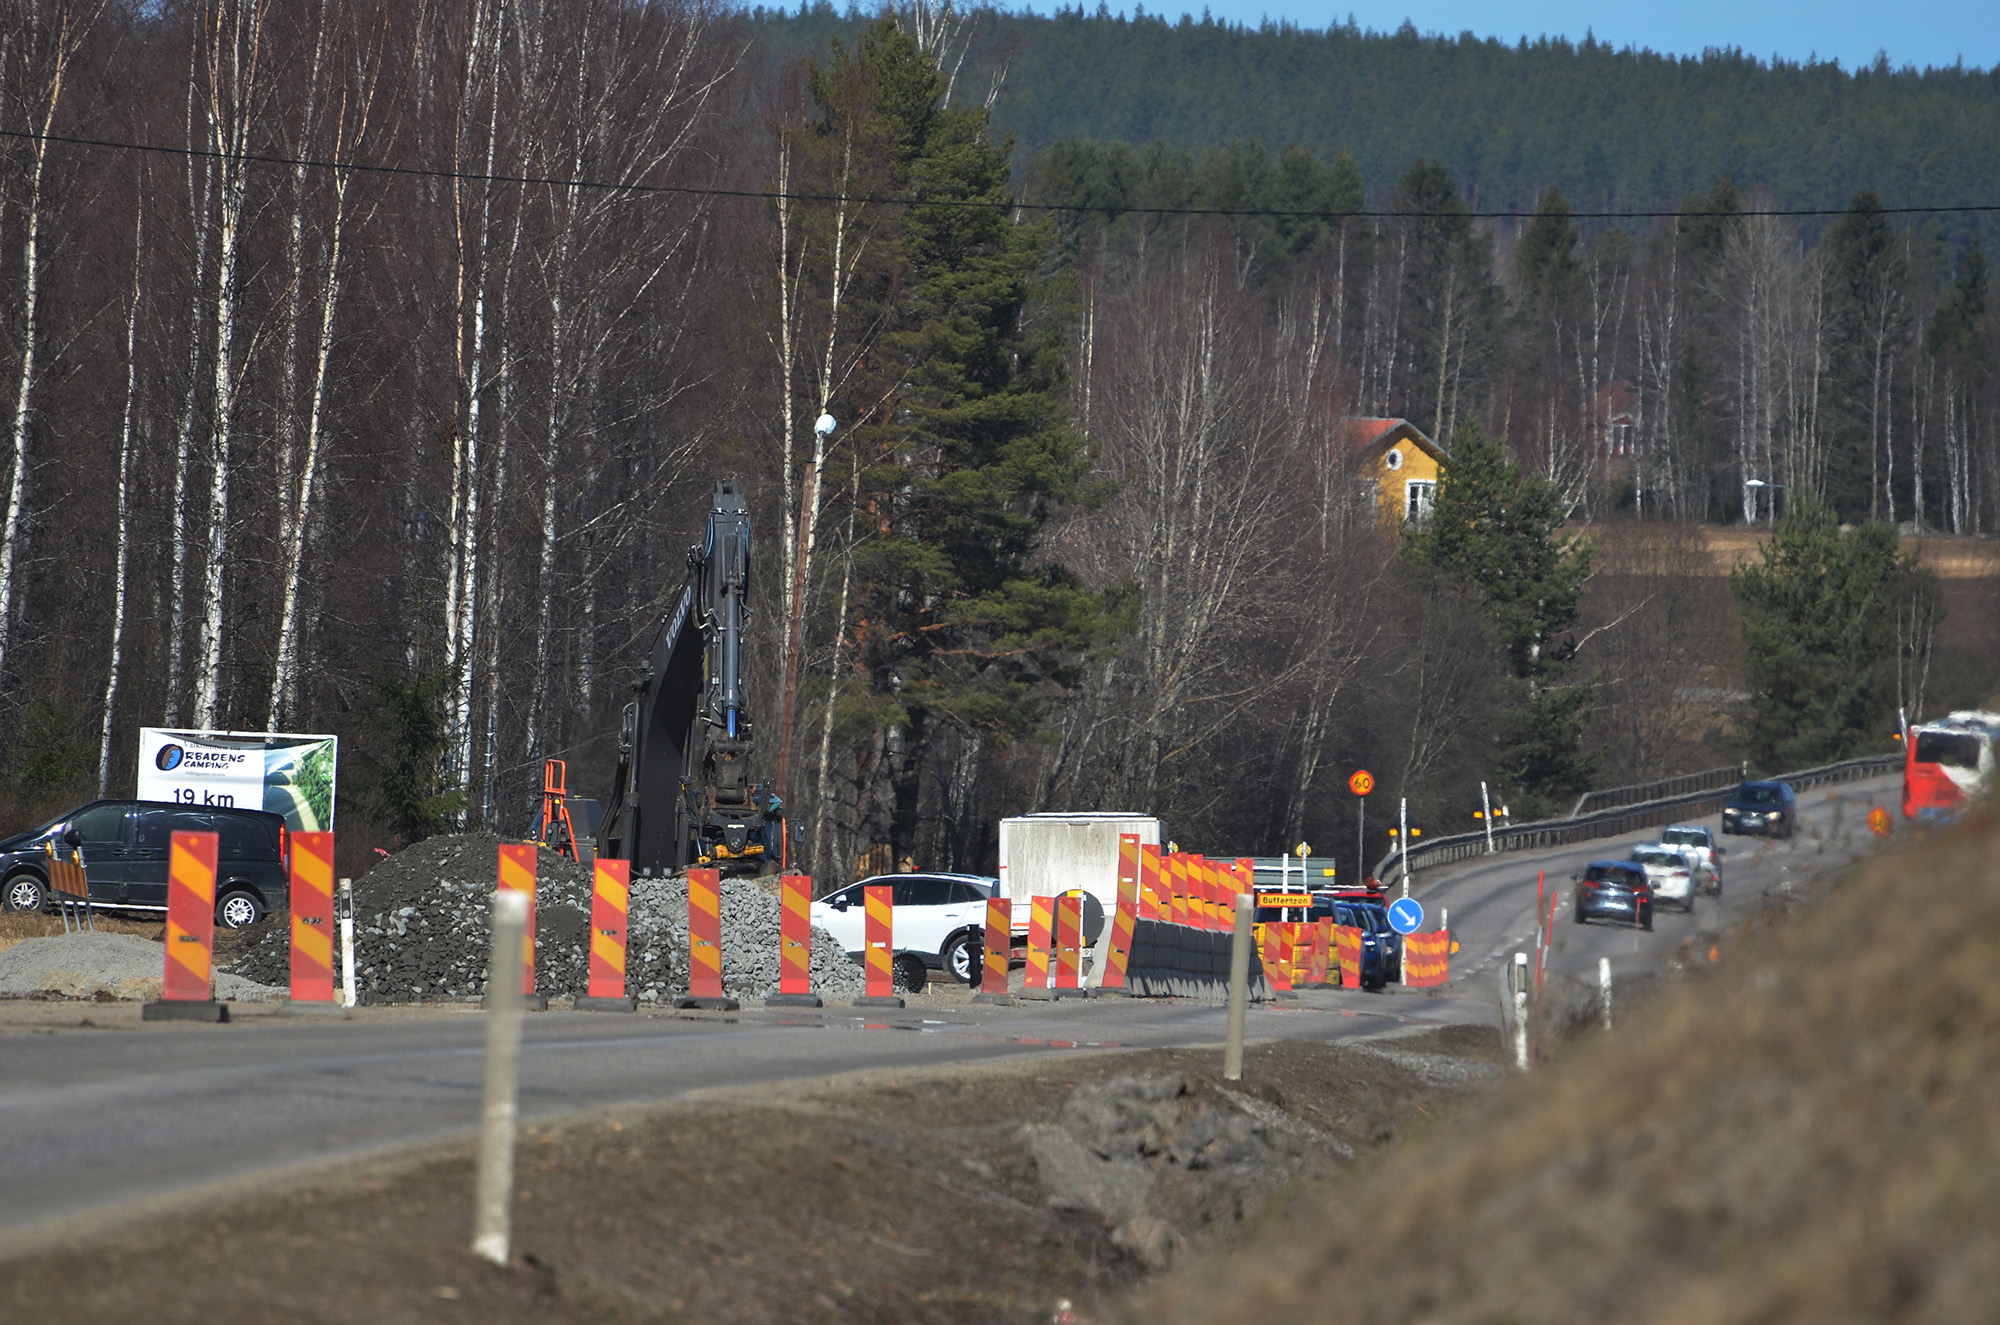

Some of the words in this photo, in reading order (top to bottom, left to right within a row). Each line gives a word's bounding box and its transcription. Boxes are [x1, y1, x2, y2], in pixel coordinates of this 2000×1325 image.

[665, 585, 691, 649] VOLVO
[183, 760, 229, 769] CAMPING
[1353, 776, 1371, 789] 60
[173, 788, 195, 804] 19
[204, 789, 235, 808] km
